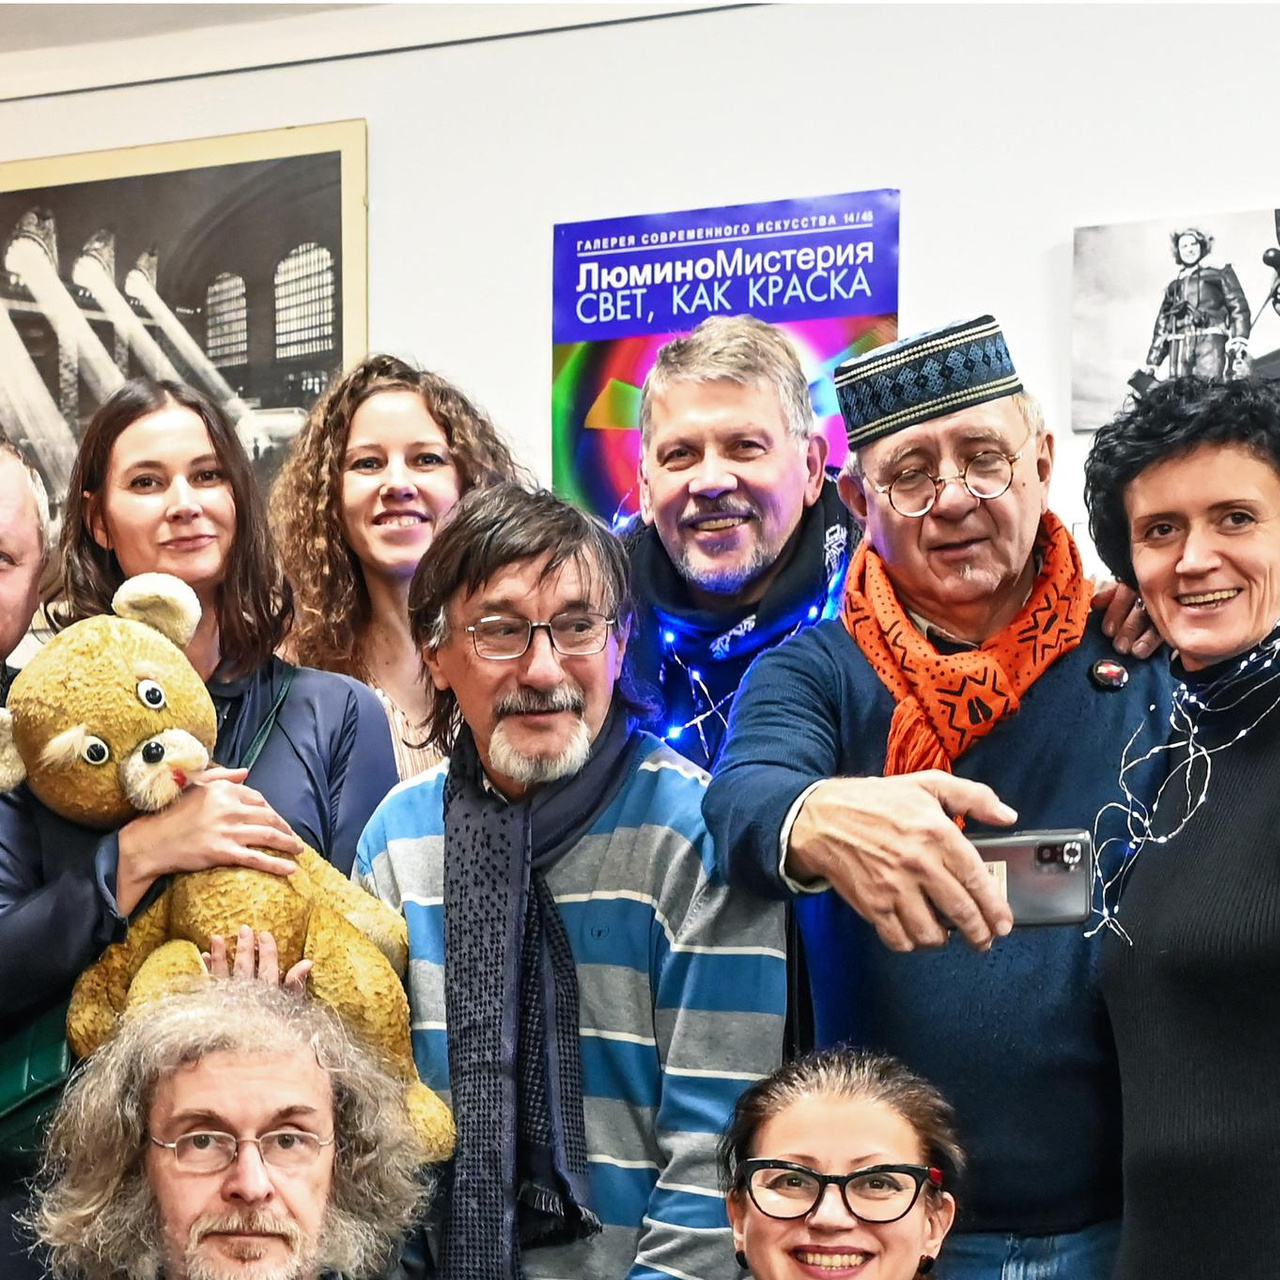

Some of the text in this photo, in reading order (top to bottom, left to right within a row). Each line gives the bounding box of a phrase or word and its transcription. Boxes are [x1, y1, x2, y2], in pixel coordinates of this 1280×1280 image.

[576, 210, 874, 251] ГАЛЕРЕЯ СОВРЕМЕННОГО ИСКУССТВА 14/45
[576, 241, 874, 292] ЛюминоМистерия
[576, 266, 872, 324] СВЕТ, КАК КРАСКА
